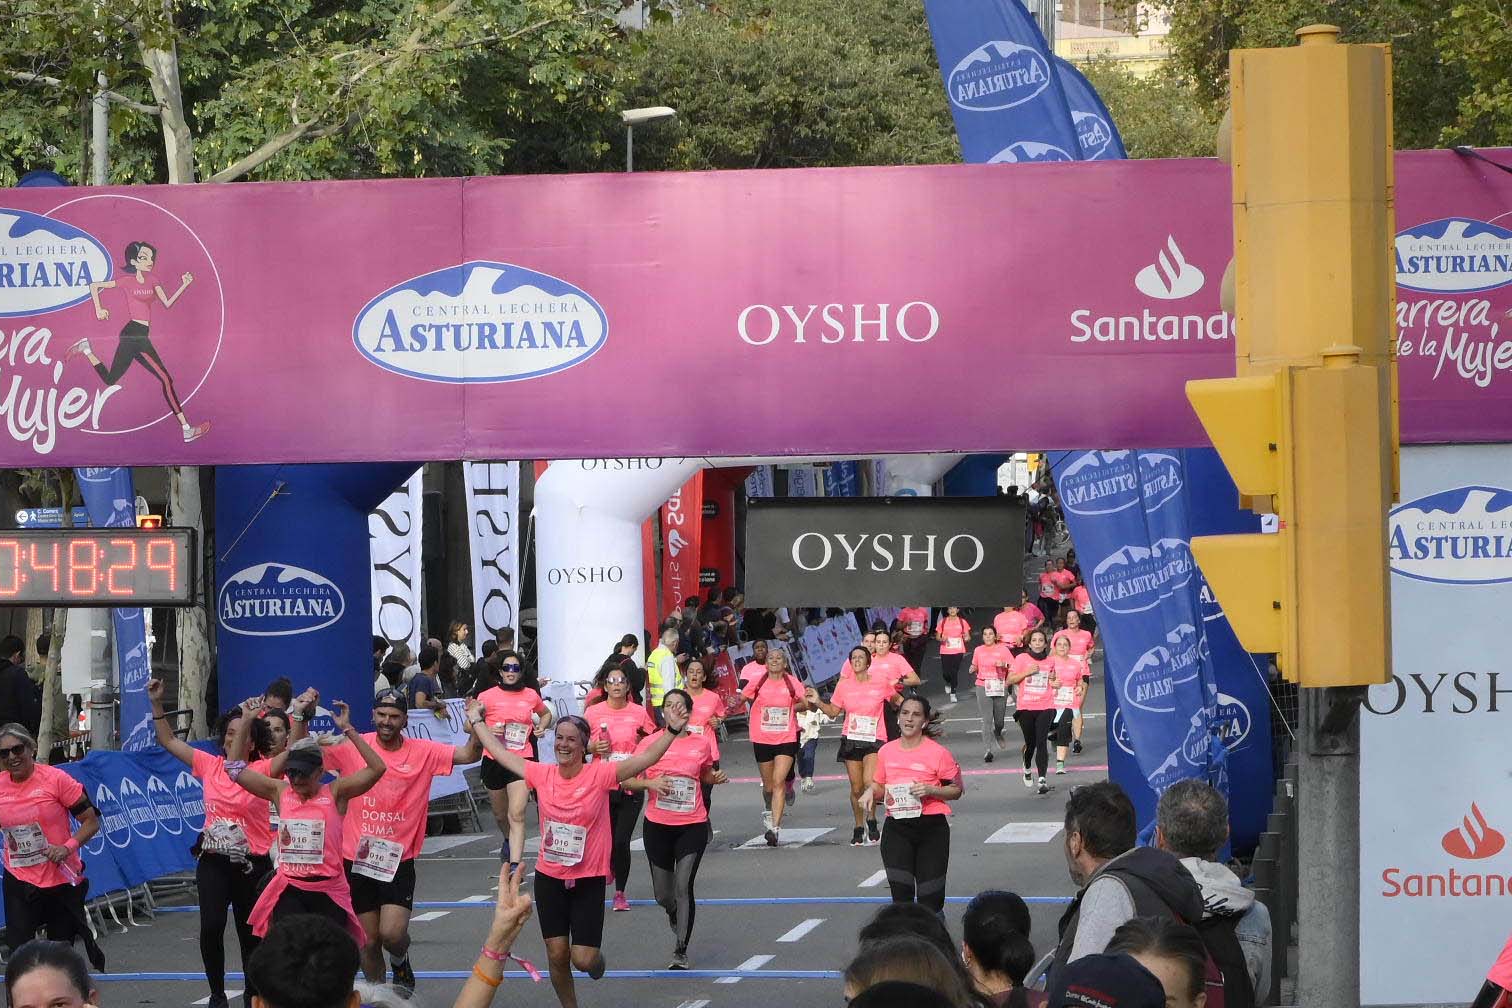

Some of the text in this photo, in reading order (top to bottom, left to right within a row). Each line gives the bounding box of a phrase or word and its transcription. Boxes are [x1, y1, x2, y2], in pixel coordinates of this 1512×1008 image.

[15, 244, 88, 256] LECHERA
[1410, 243, 1512, 252] CENTRAL LECHER
[1395, 250, 1512, 274] ASTURIAN
[412, 302, 580, 316] CENTRAL LECHERA
[1395, 299, 1491, 327] arrera
[372, 308, 589, 353] ASTURIANA
[737, 301, 940, 345] OYSHO
[1419, 323, 1512, 387] la Muje
[1417, 520, 1484, 531] CENTRAL
[791, 532, 985, 573] OYSHO
[548, 566, 623, 585] OYSHO
[234, 587, 331, 597] CENTRAL LECHERA
[223, 591, 336, 620] ASTURIANA
[363, 796, 376, 806] TU
[361, 810, 406, 822] DORSAL
[361, 822, 395, 835] SUMA
